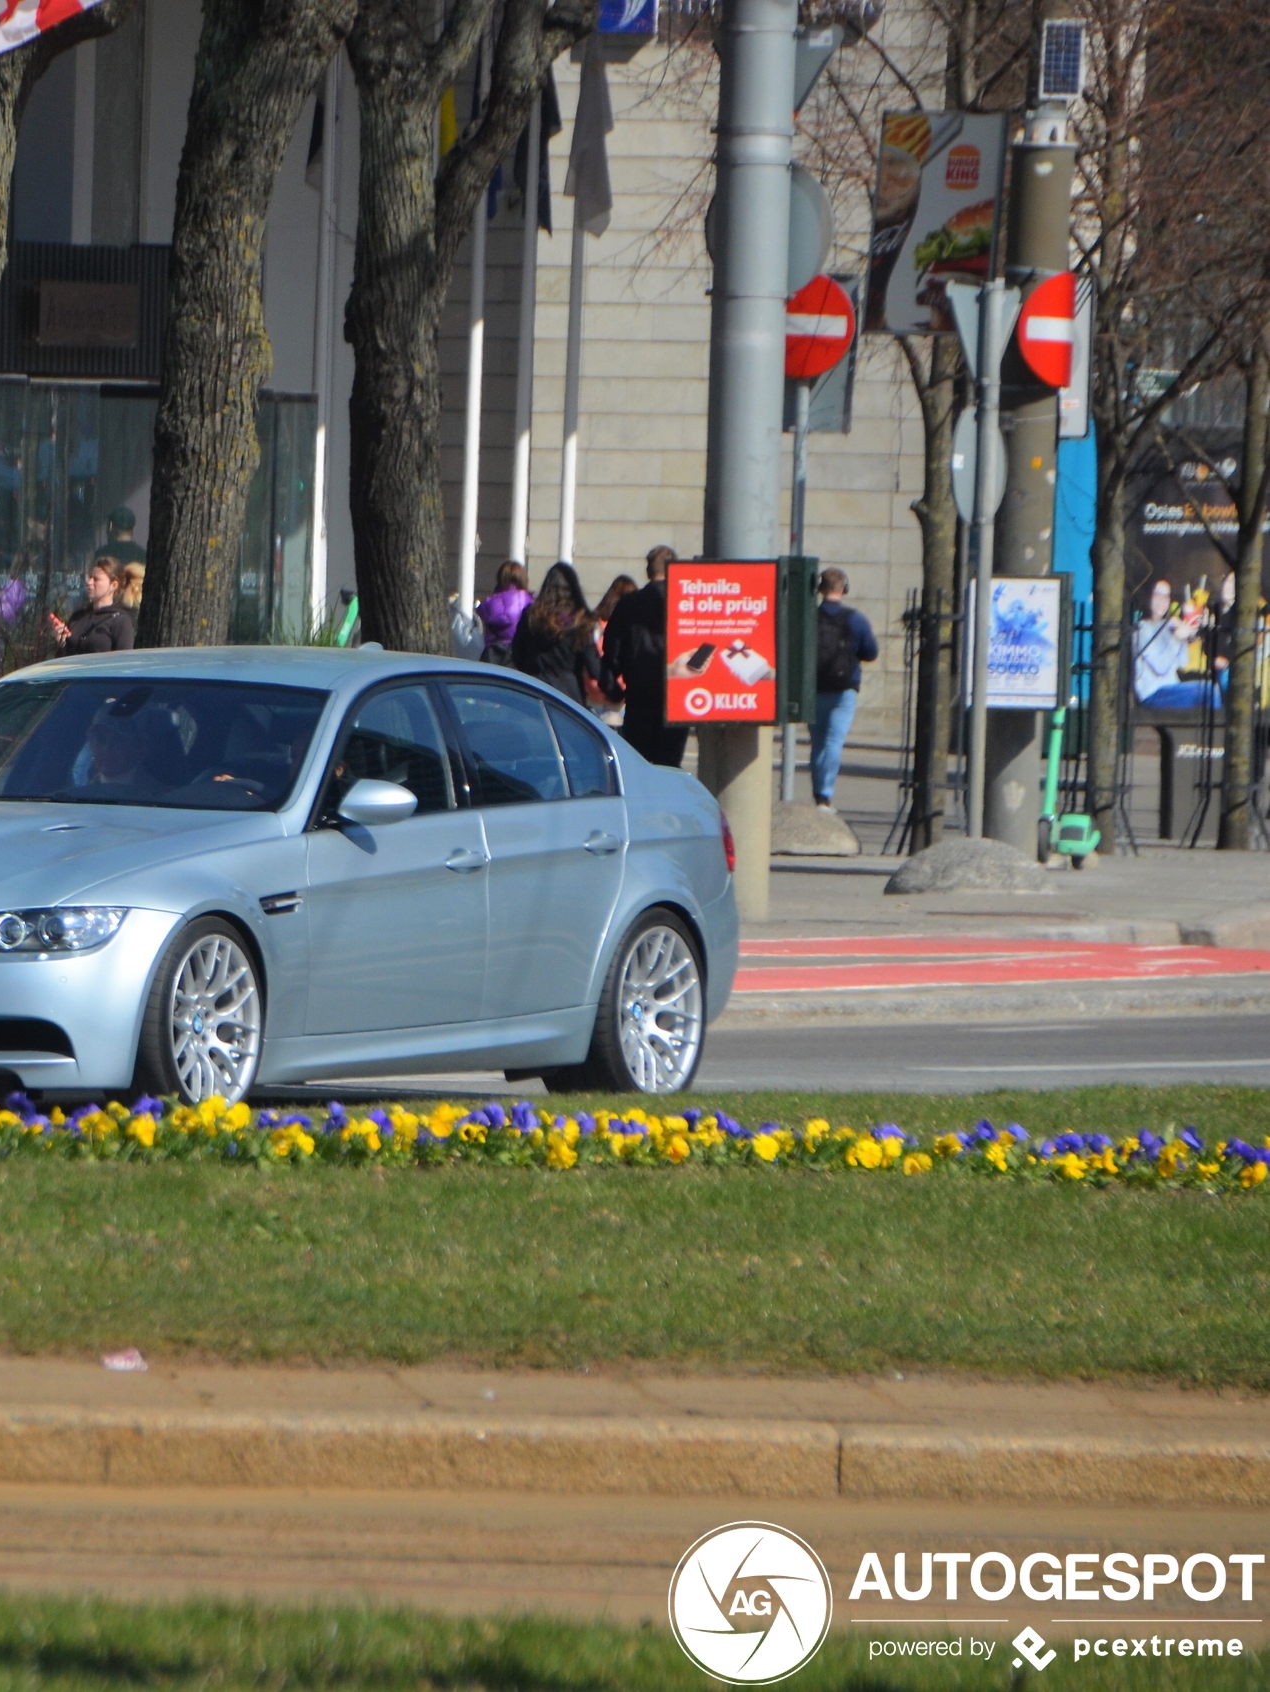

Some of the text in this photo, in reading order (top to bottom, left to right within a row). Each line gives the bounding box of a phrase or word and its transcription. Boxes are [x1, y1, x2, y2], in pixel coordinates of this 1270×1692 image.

[946, 167, 980, 181] KING
[679, 579, 740, 594] Tehnika
[679, 597, 767, 615] ei ole prügi
[987, 662, 1039, 675] SOOLO
[715, 694, 757, 710] KLICK
